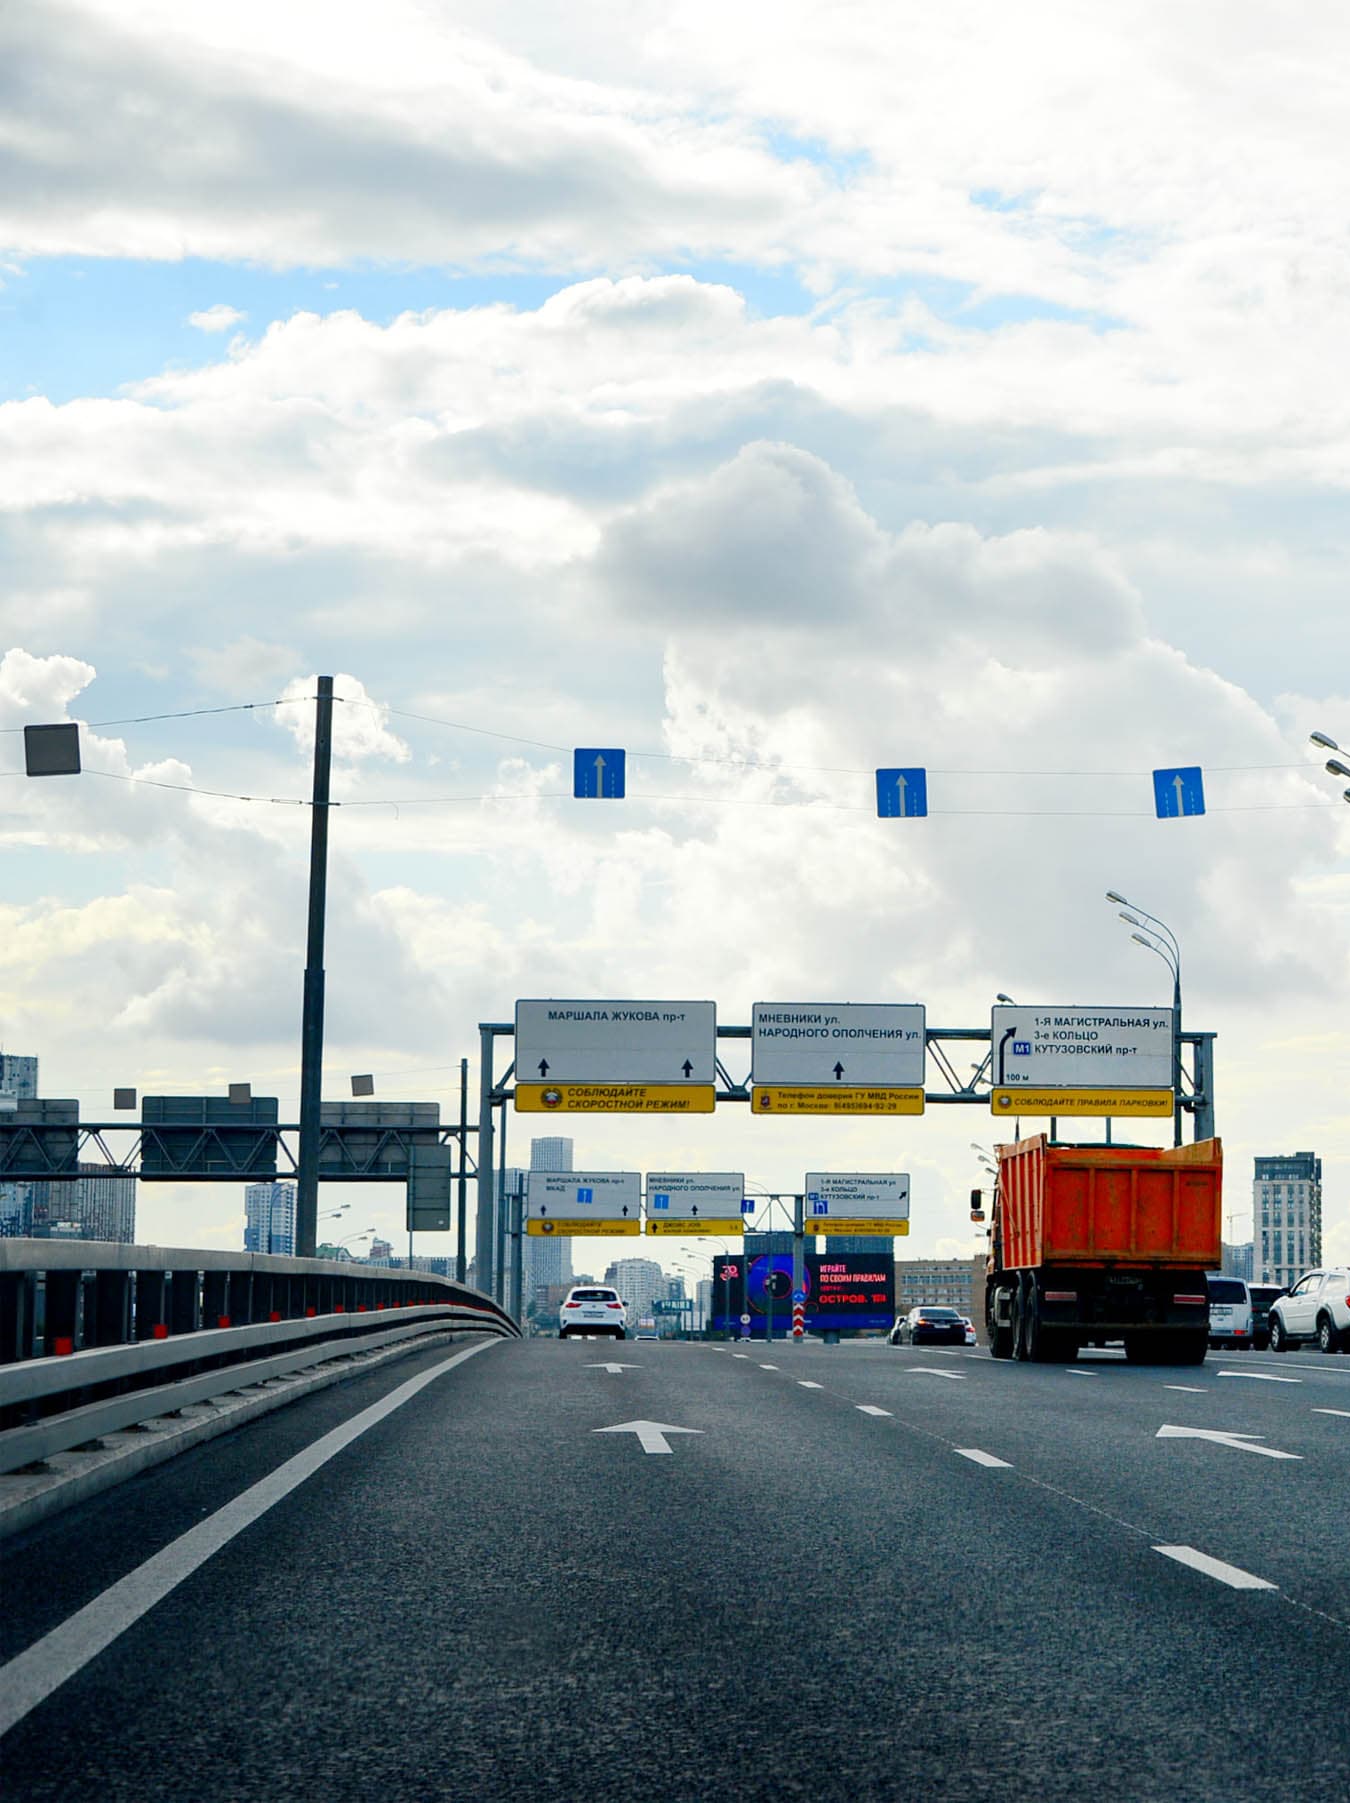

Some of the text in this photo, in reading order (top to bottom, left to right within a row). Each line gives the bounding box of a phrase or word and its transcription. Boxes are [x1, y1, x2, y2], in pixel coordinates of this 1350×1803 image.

[548, 1011, 685, 1023] МАРШАЛА ЖУКОВА пр-т
[758, 1014, 840, 1025] МНЕВНИКИ ул.
[1034, 1018, 1169, 1029] 1-Я МАГИСТРАЛЬНАЯ ул.
[758, 1028, 922, 1041] НАРОДНОГО ОПОЛЧЕНИЯ ул.
[1034, 1031, 1098, 1041] 3-е КОЛЬЦО
[1034, 1044, 1113, 1054] КУТУЗОВСКИЙ
[1115, 1047, 1138, 1056] пр-т
[567, 1087, 647, 1097] СОБЛЮДАЙТЕ
[778, 1091, 815, 1100] Телефон
[868, 1093, 887, 1101] МВД
[889, 1093, 919, 1101] России
[567, 1098, 690, 1109] СКОРОСТНОЙ РЕЖИМ!
[1014, 1098, 1075, 1106] СОБЛЮДАЙТЕ
[1077, 1098, 1117, 1106] ПРАВИЛА
